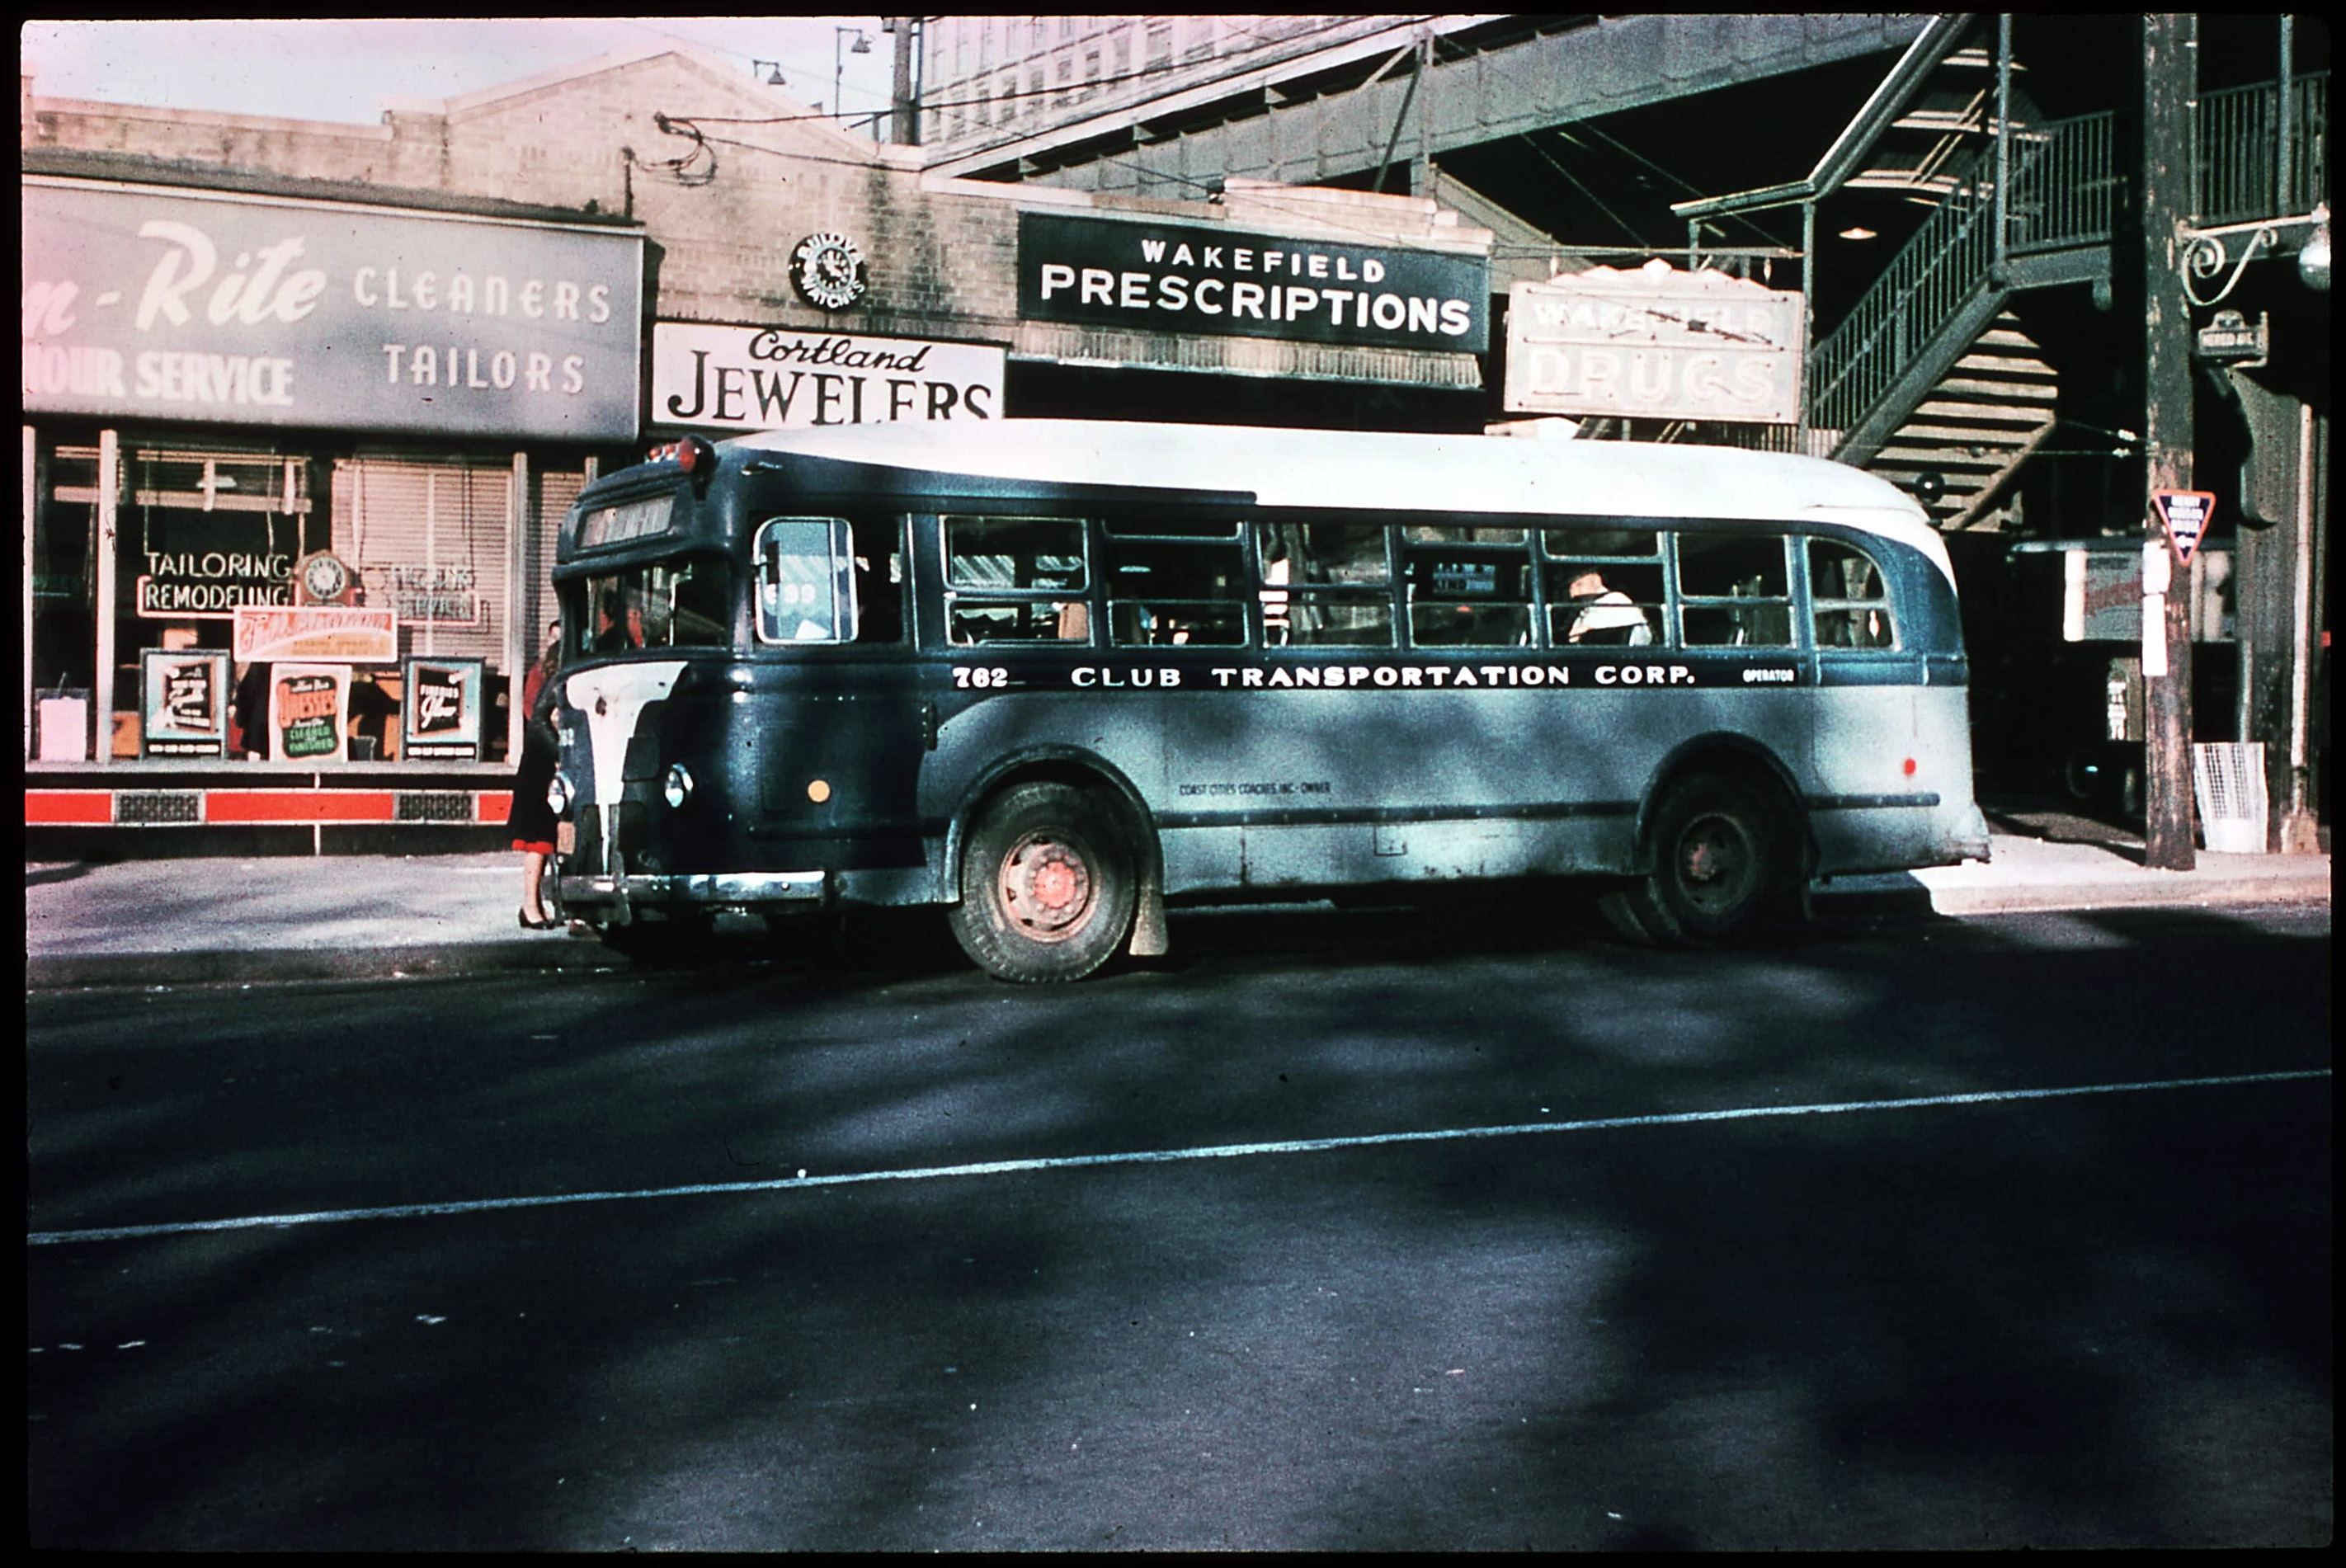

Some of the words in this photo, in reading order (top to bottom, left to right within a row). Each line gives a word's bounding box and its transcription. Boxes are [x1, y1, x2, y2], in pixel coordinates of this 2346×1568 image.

[797, 232, 866, 266] BULOVA
[1141, 238, 1387, 284] WAKEFIELD
[354, 265, 611, 324] CLEANERS
[800, 273, 866, 309] WATCHES
[1040, 263, 1471, 337] PRESCRIPTIONS
[382, 343, 586, 395] TAILORS
[748, 330, 933, 373] Cortland
[134, 351, 295, 407] SERVICE
[667, 349, 992, 426] JEWELERS
[1529, 347, 1774, 403] DRUGS
[147, 552, 292, 579] TAILORING
[144, 583, 290, 610] REMODELING
[952, 666, 1008, 688] 762
[1071, 666, 1182, 687] CLUB
[1211, 666, 1570, 687] TRANSPORTATION
[1594, 666, 1696, 685] CORP.
[1742, 668, 1795, 683] OPERATOR
[1179, 783, 1206, 796] COAST
